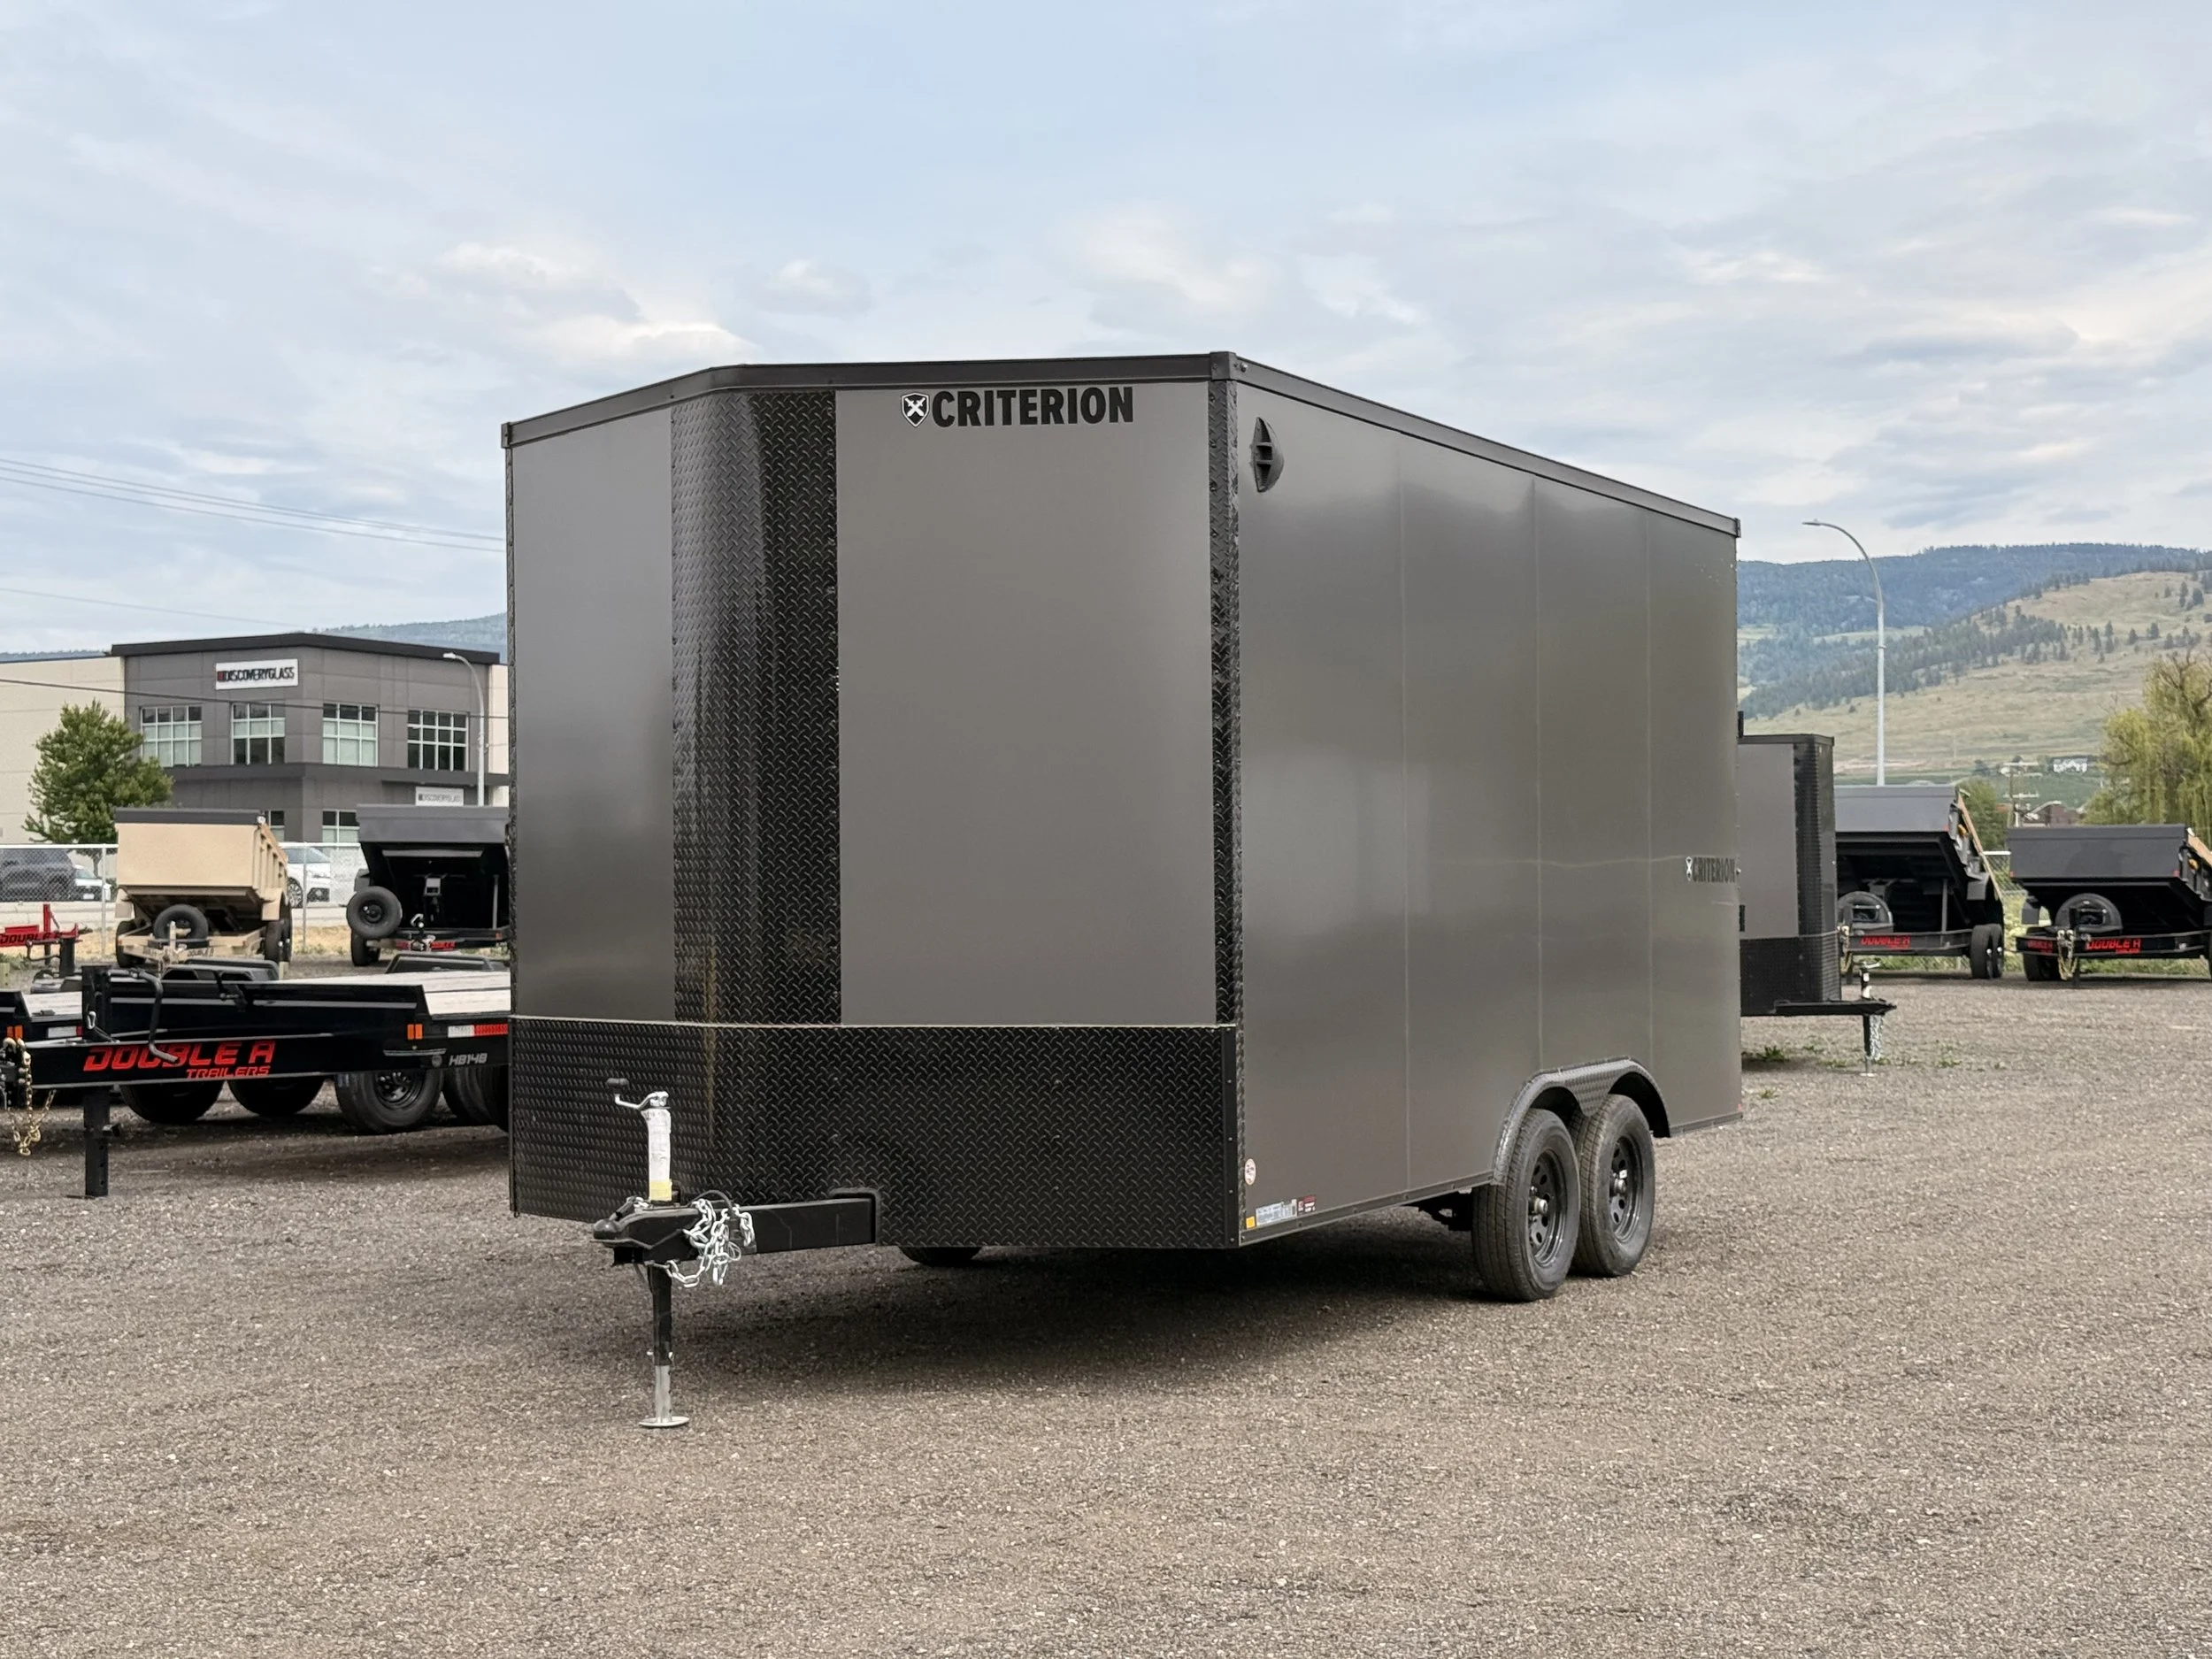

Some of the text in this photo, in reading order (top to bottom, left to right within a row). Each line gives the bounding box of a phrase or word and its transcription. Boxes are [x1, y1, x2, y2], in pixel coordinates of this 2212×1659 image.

[932, 387, 1133, 428] CRITERION
[2085, 939, 2131, 950] DOUBLE
[83, 1040, 276, 1071] DOUBLE A
[186, 1065, 271, 1079] TRAILERS
